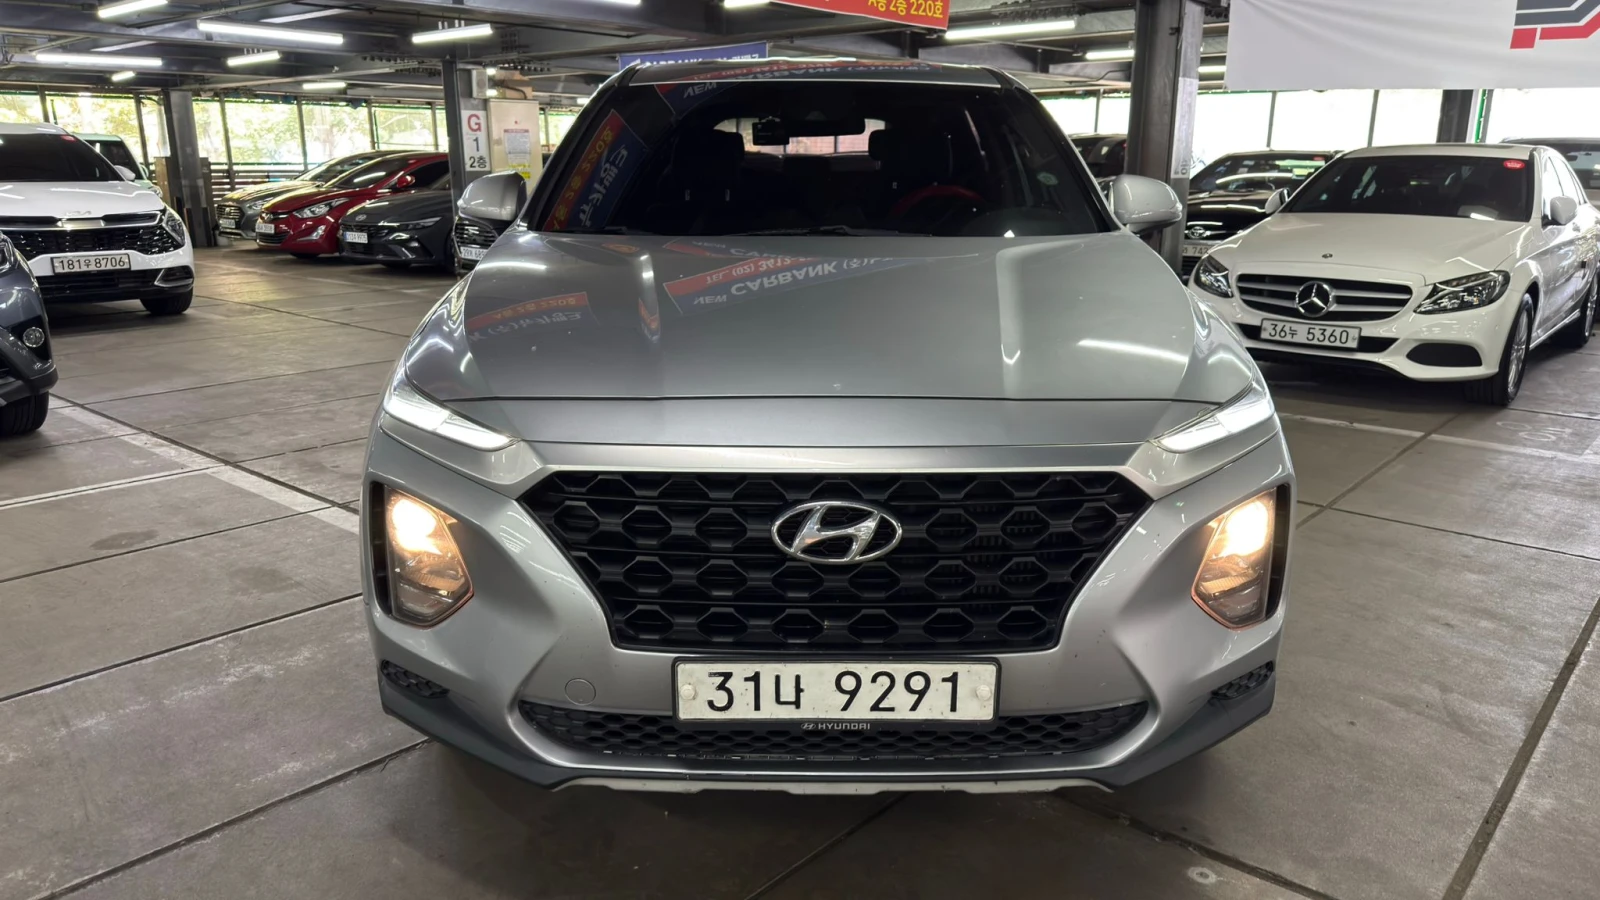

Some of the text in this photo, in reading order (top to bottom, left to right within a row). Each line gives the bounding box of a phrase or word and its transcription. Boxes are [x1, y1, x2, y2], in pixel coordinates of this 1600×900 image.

[910, 0, 944, 18] 220호
[467, 113, 482, 132] G
[473, 137, 480, 152] 1
[469, 155, 487, 169] 2층
[1269, 323, 1349, 345] 36누 5360
[707, 670, 959, 712] 31나 9291
[818, 722, 871, 730] HYUNDAI
